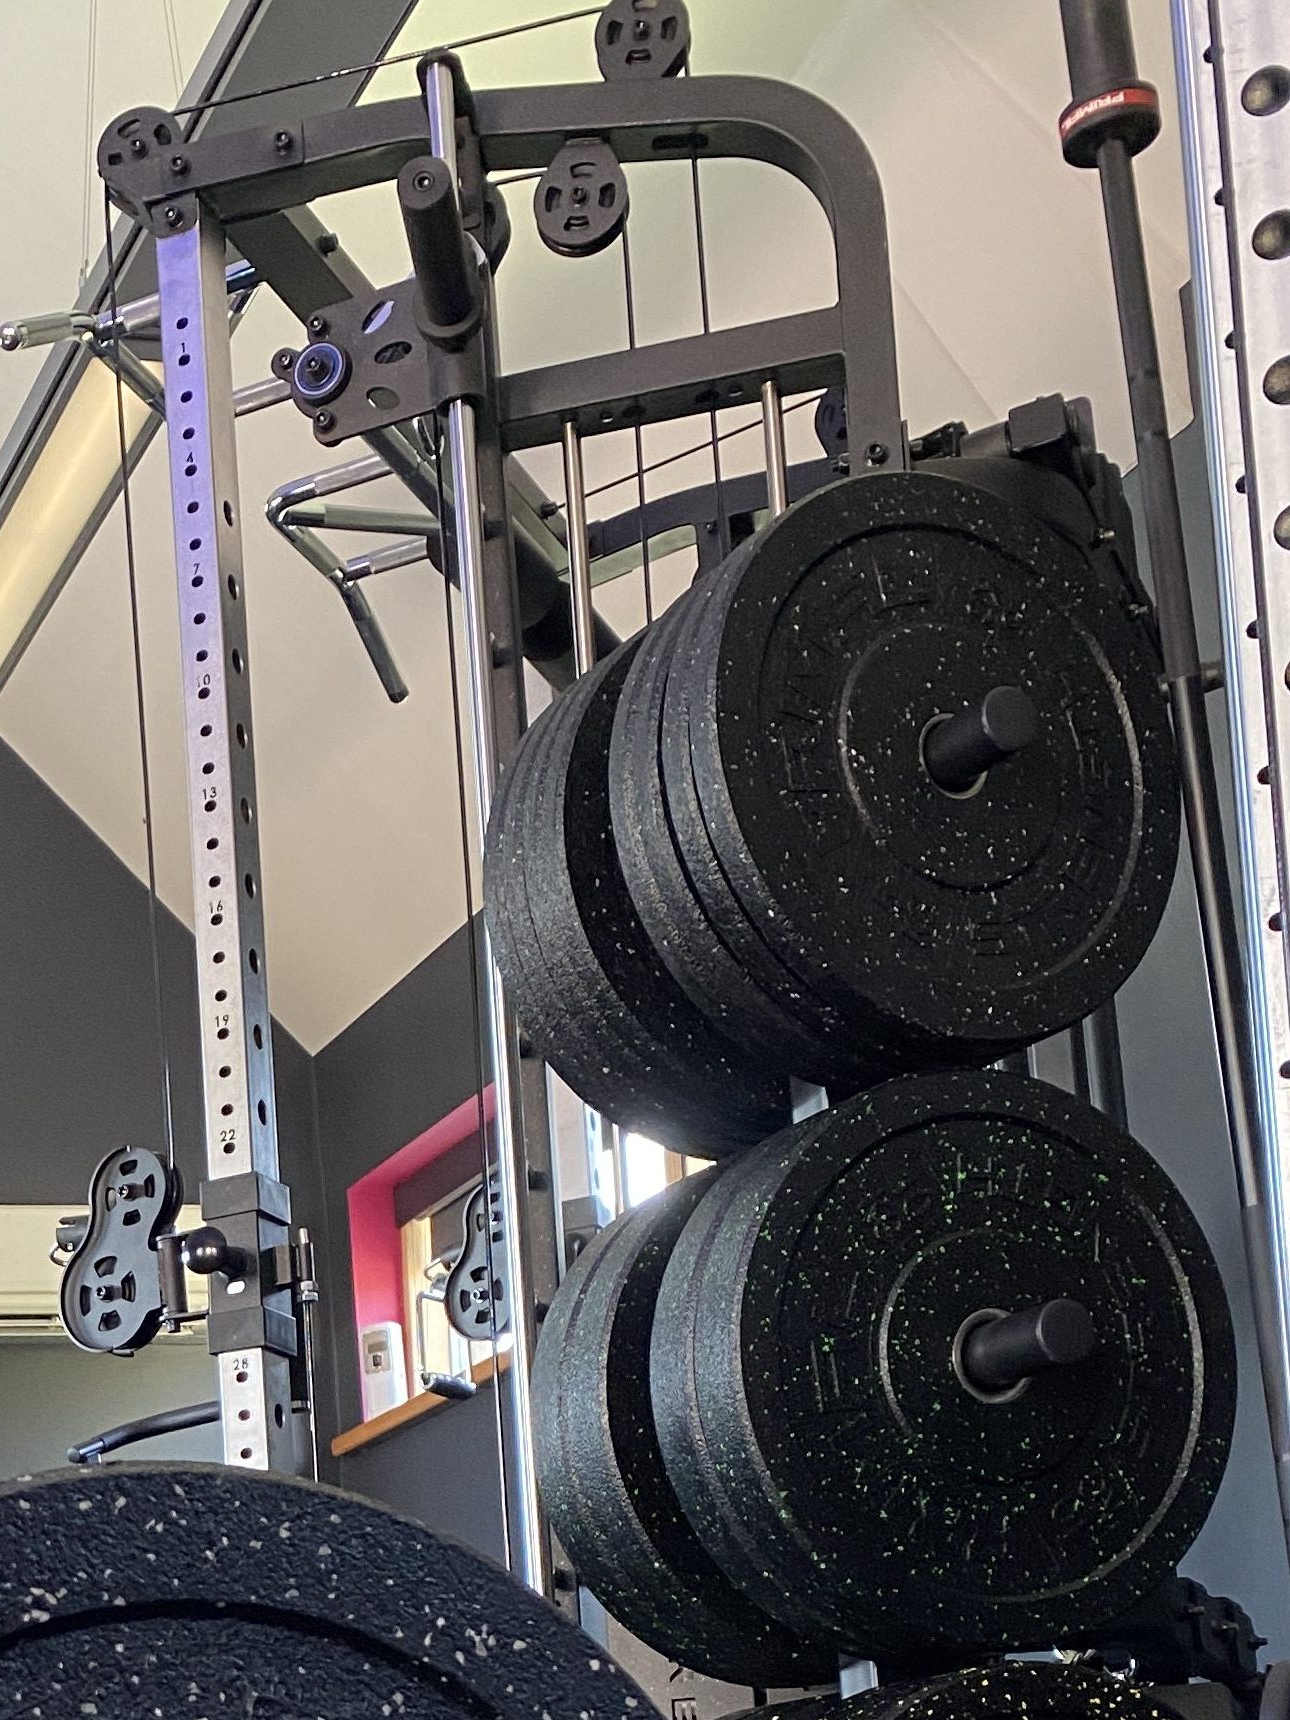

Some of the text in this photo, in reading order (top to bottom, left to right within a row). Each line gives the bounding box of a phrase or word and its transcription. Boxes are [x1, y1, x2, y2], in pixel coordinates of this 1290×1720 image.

[202, 787, 217, 799] 13
[208, 901, 223, 912] 16
[214, 1015, 229, 1027] 19
[221, 1130, 236, 1142] 22
[233, 1358, 248, 1370] 28
